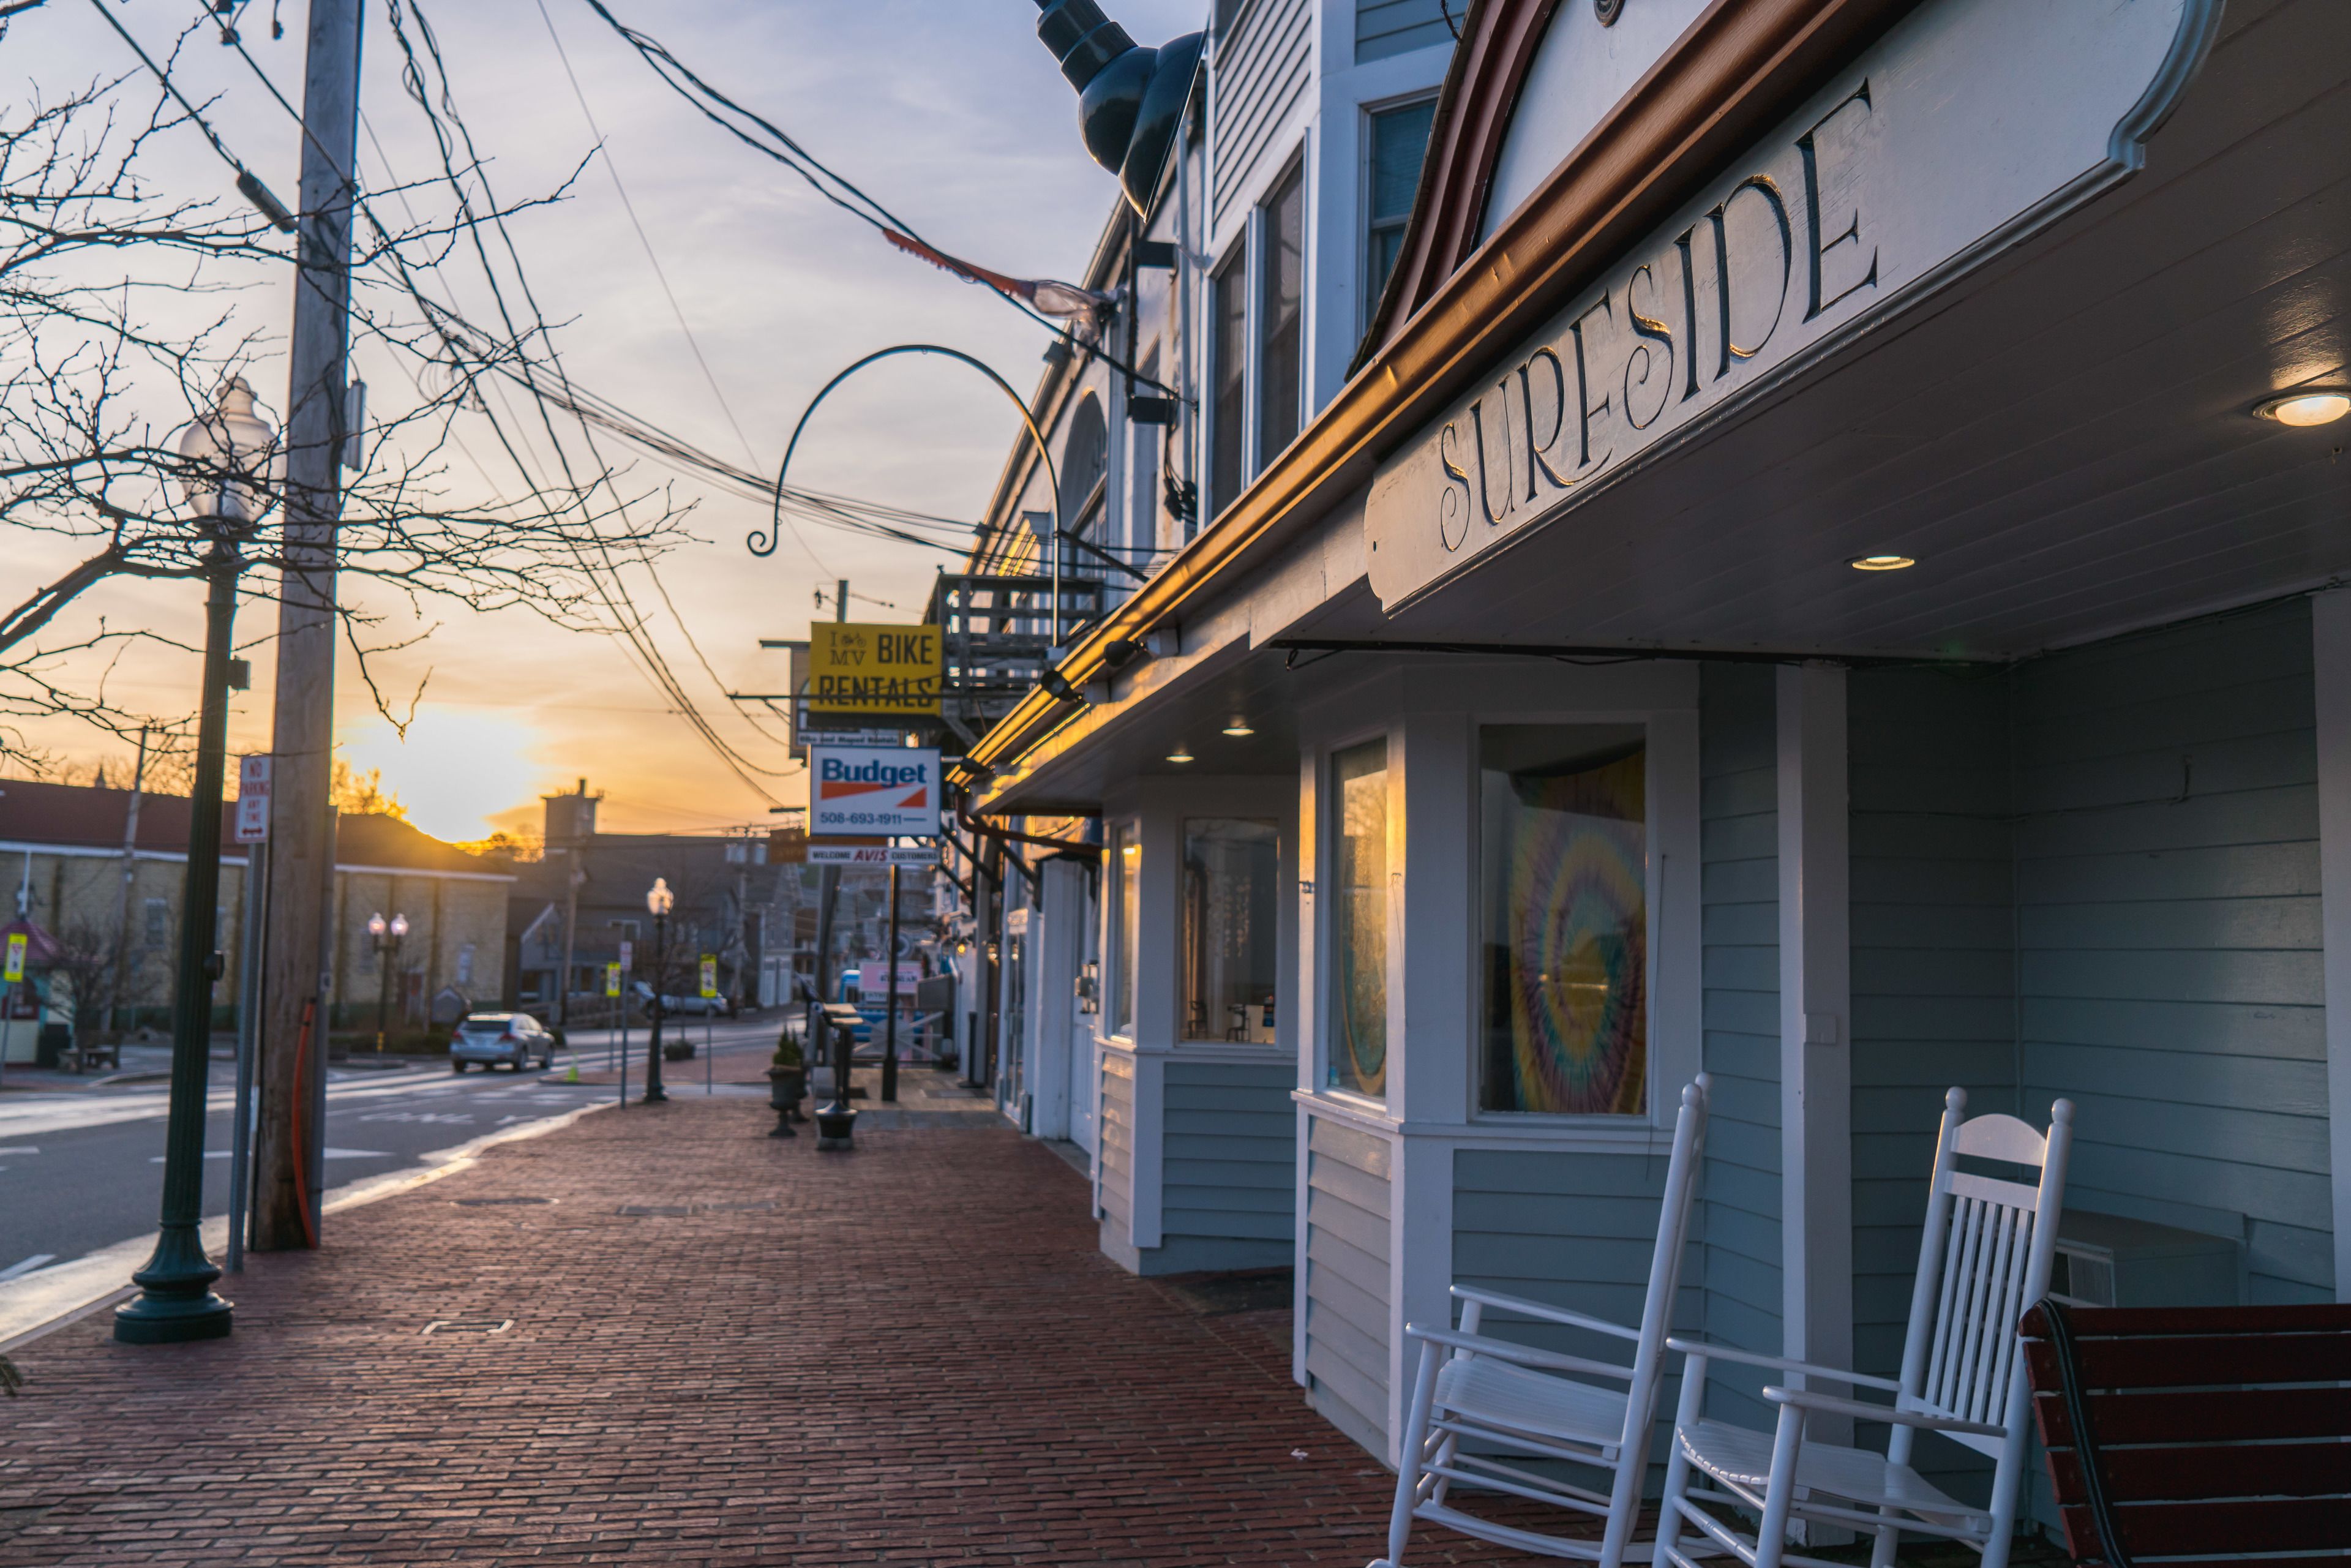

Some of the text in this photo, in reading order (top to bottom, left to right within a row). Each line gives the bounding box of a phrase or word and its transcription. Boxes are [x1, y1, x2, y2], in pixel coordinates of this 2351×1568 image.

[1440, 77, 1878, 552] SURFSIDE
[830, 631, 838, 647] I
[830, 649, 867, 666] MV
[878, 634, 934, 665] BIKE
[819, 675, 934, 707] RENTALS
[249, 760, 263, 778] NO
[822, 758, 928, 788] Budget
[820, 812, 902, 825] 508-693-1911
[853, 849, 888, 862] AVIS
[891, 852, 937, 860] CUSTOMERS
